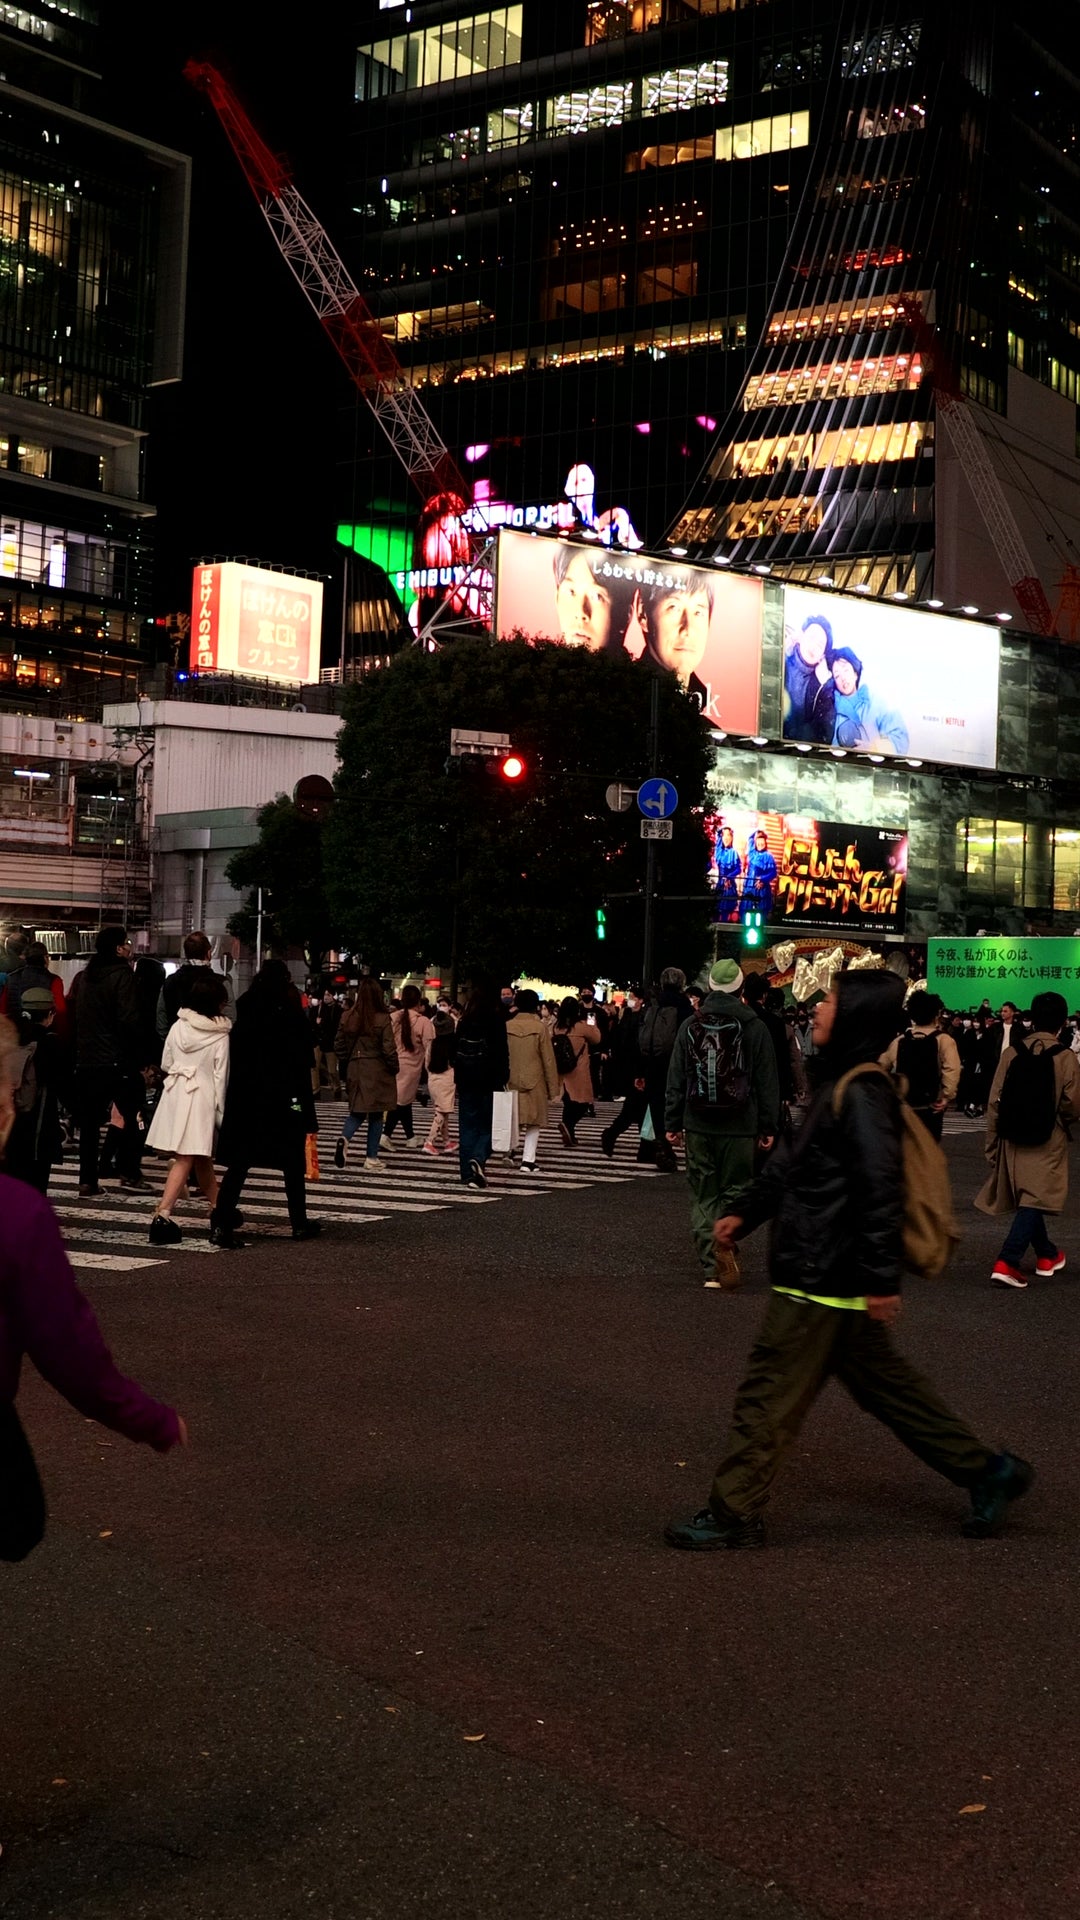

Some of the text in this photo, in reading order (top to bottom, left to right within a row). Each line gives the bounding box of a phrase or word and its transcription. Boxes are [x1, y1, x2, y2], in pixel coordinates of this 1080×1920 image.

[197, 569, 213, 667] ほけんの窓口
[243, 587, 310, 622] ほけんの
[257, 620, 297, 648] 窓口
[248, 648, 300, 671] グループ
[781, 838, 862, 883] にしたん
[936, 948, 1033, 961] 今夜、私が頂くのは、
